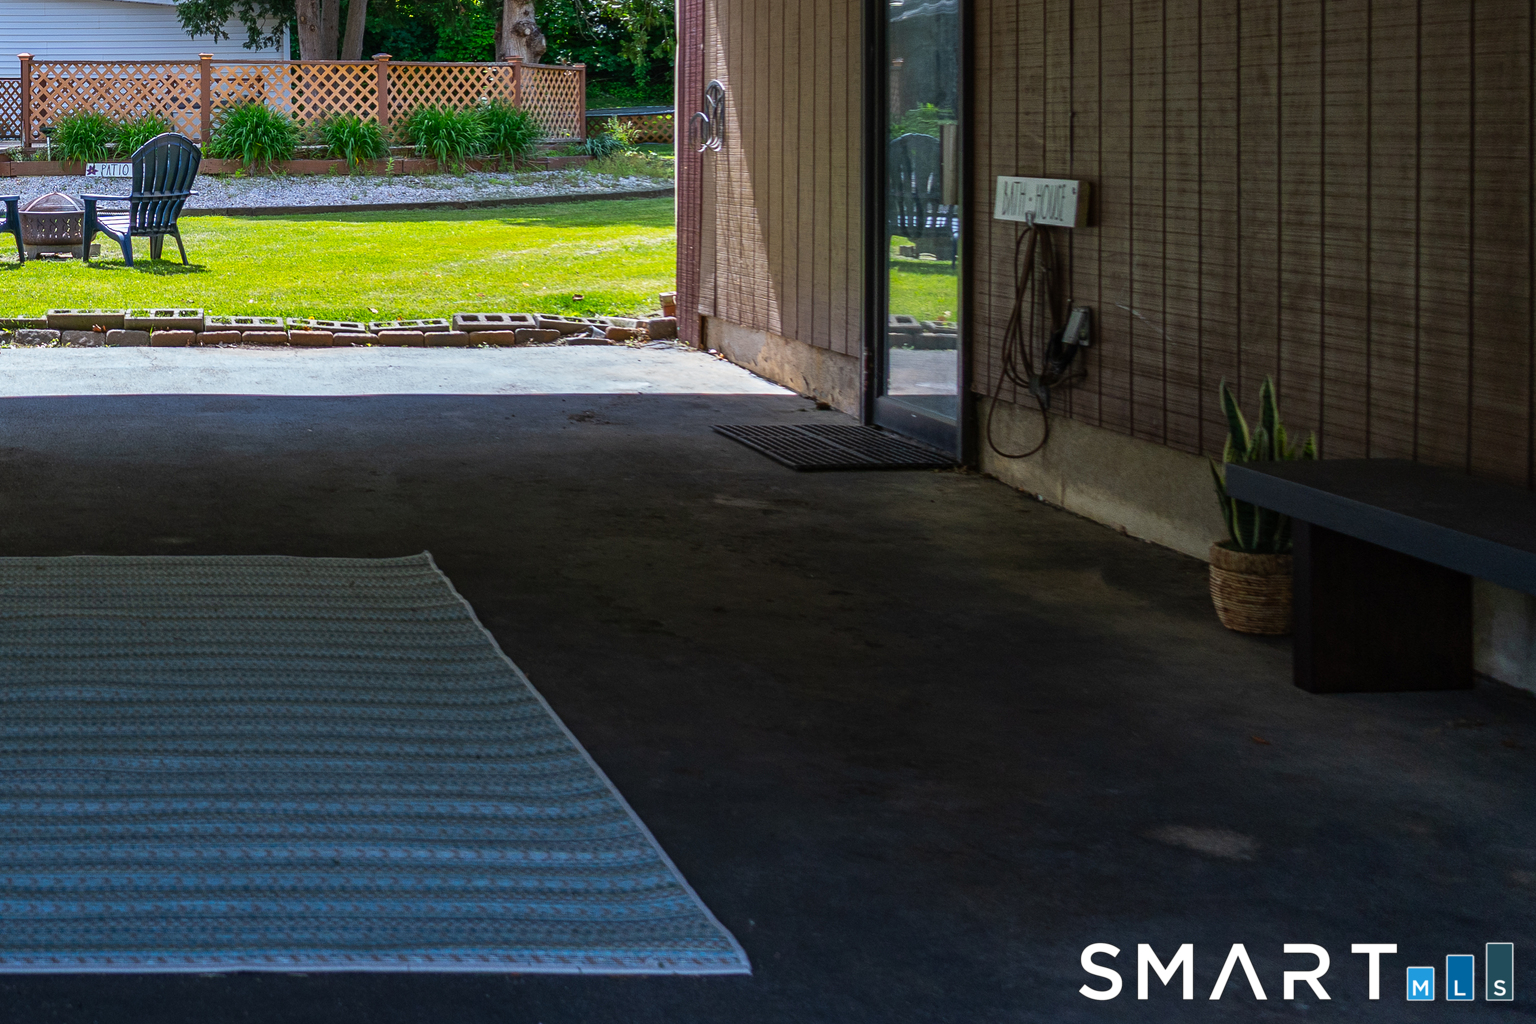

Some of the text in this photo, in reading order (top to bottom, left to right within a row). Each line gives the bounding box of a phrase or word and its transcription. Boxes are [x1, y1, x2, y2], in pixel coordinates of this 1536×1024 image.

[101, 163, 130, 176] PATIO
[1001, 180, 1067, 222] BATH HOUSE
